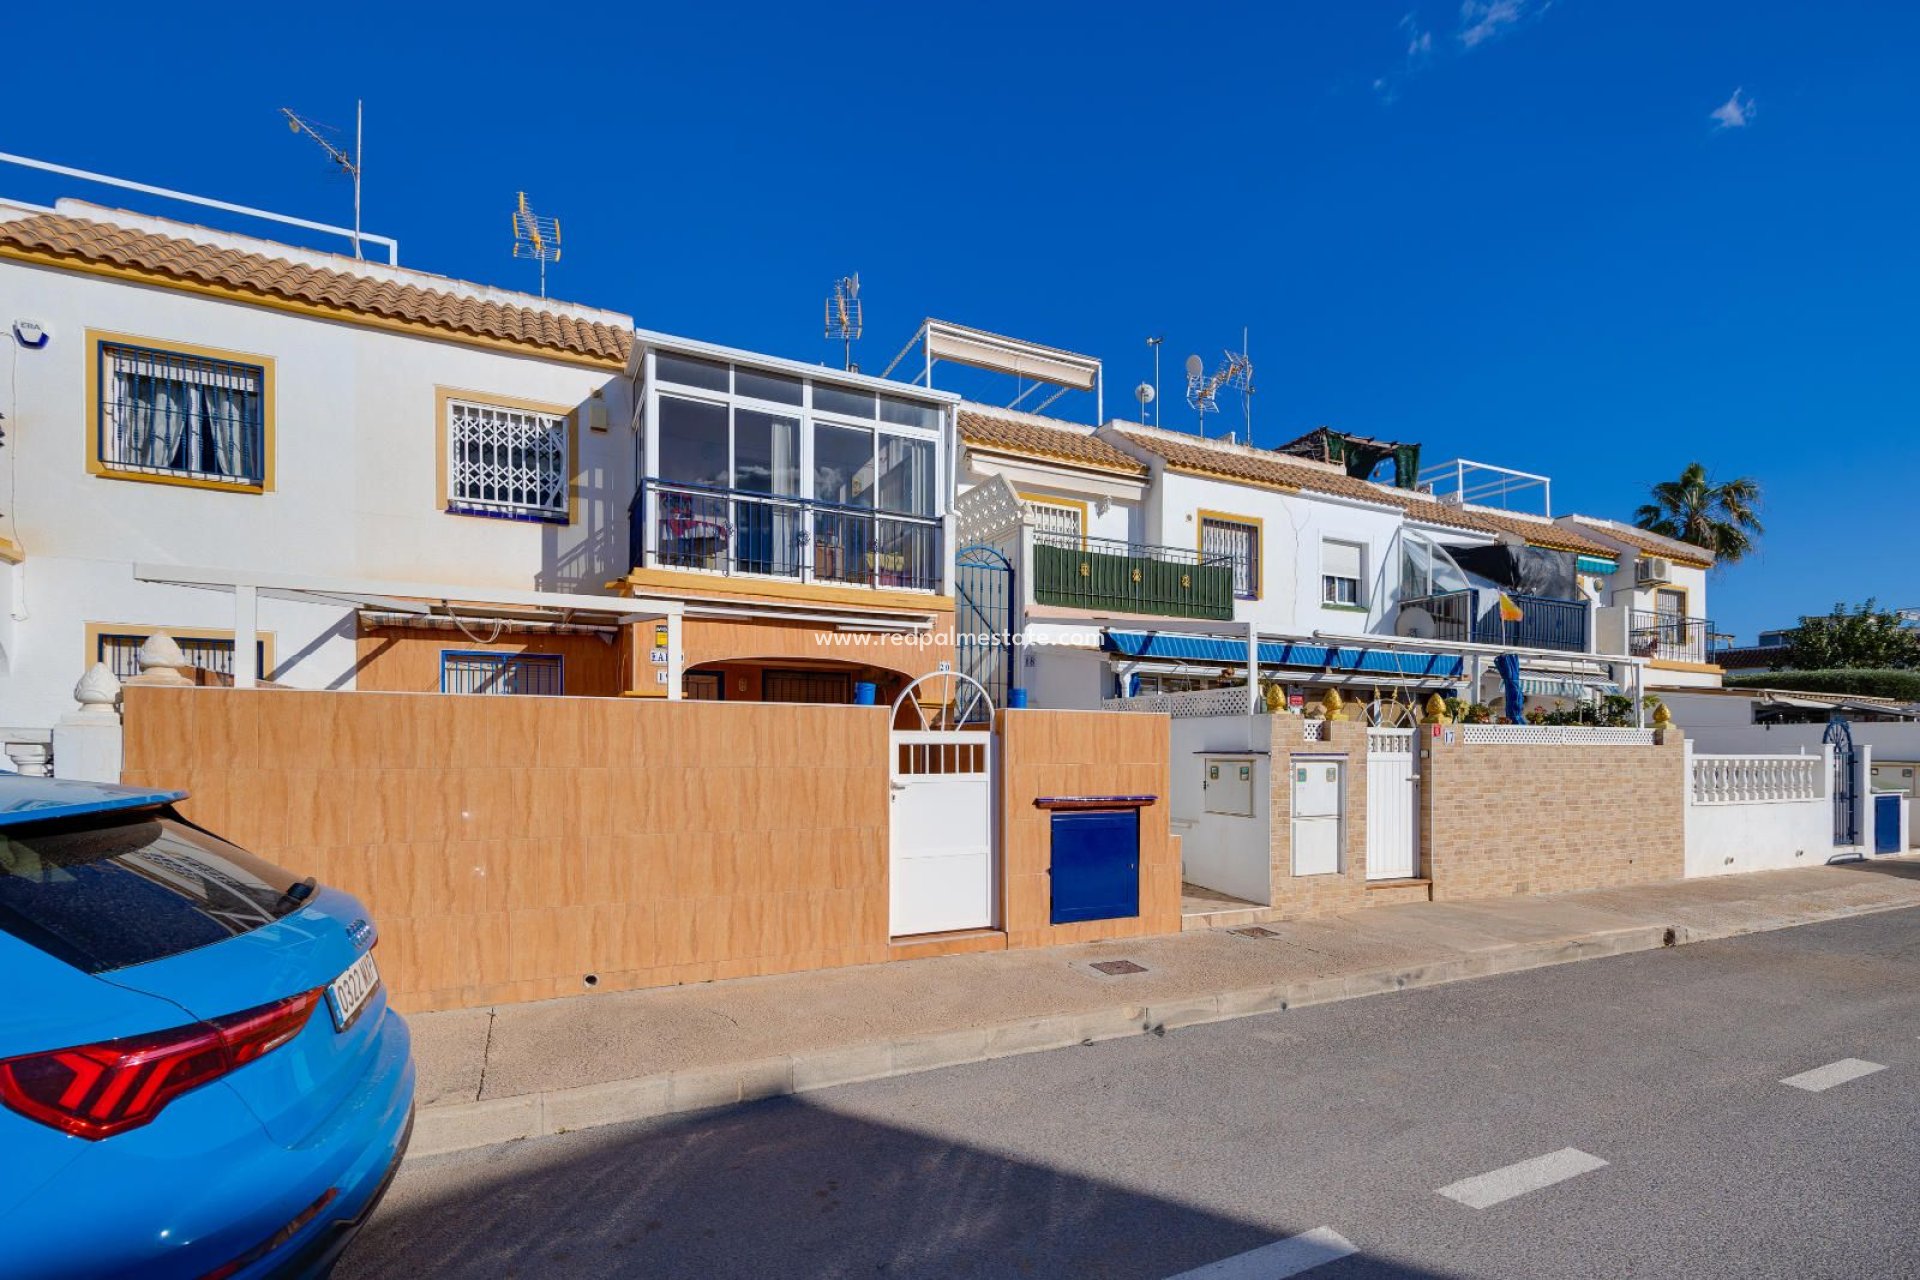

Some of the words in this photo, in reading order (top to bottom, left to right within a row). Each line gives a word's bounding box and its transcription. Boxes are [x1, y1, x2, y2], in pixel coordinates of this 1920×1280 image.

[940, 663, 950, 672] 20
[1445, 731, 1454, 743] 17
[337, 968, 365, 1014] 0322
